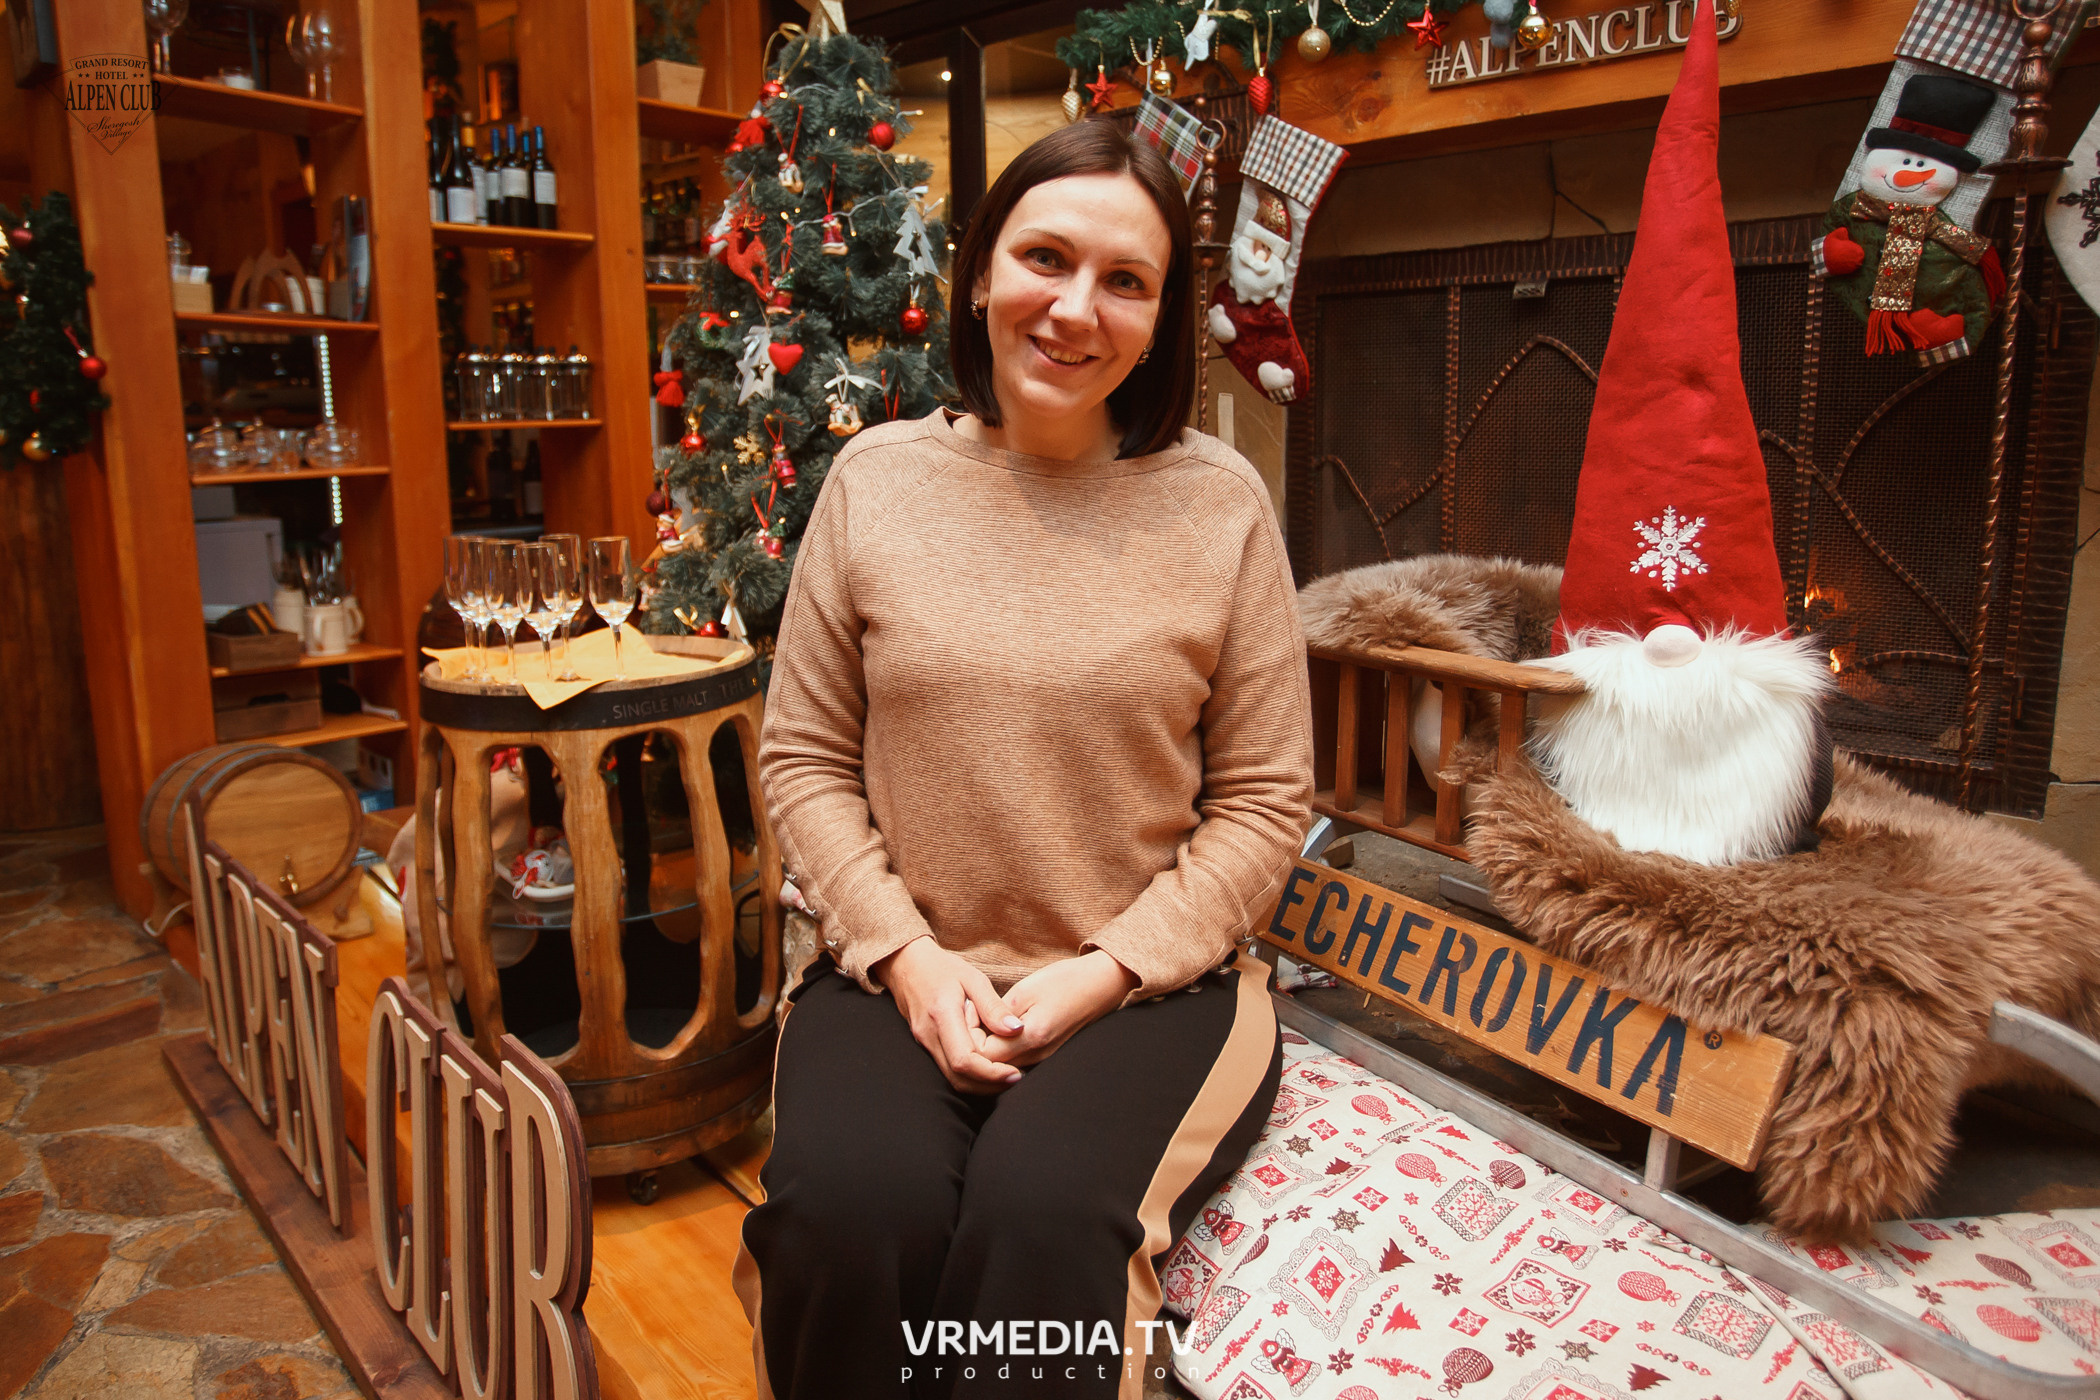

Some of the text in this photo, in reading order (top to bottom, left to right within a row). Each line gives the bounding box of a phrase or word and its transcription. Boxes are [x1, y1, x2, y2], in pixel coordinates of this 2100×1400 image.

[612, 699, 670, 720] SINGLE
[673, 690, 709, 710] MALT
[1268, 865, 1689, 1118] ECHEROVKA
